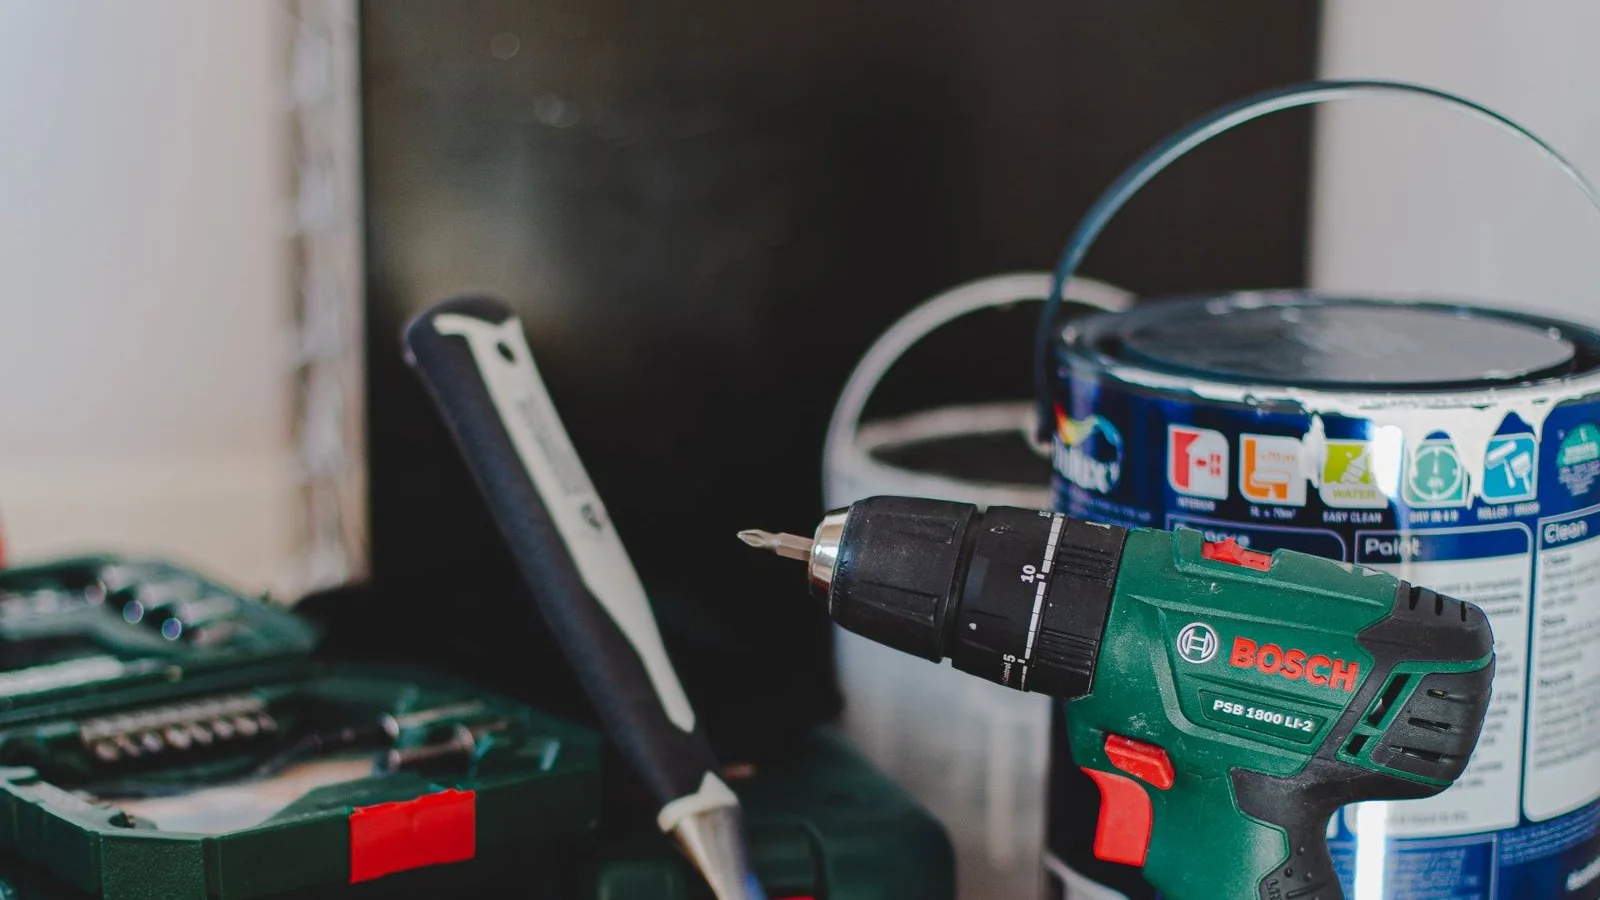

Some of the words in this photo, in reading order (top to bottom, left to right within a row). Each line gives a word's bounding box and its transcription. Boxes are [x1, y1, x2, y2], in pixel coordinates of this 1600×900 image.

[1333, 489, 1376, 500] WATER
[1323, 511, 1348, 523] EASY
[1351, 511, 1382, 523] CLEAN
[1409, 511, 1429, 524] DRY
[1477, 507, 1507, 520] ROLLER
[1544, 520, 1588, 544] Clean
[1021, 564, 1037, 584] 10
[1003, 653, 1016, 663] 5
[1229, 636, 1360, 692] BOSCH
[1213, 699, 1243, 716] PSB
[1246, 707, 1282, 726] 1800
[1284, 715, 1316, 733] LI-2
